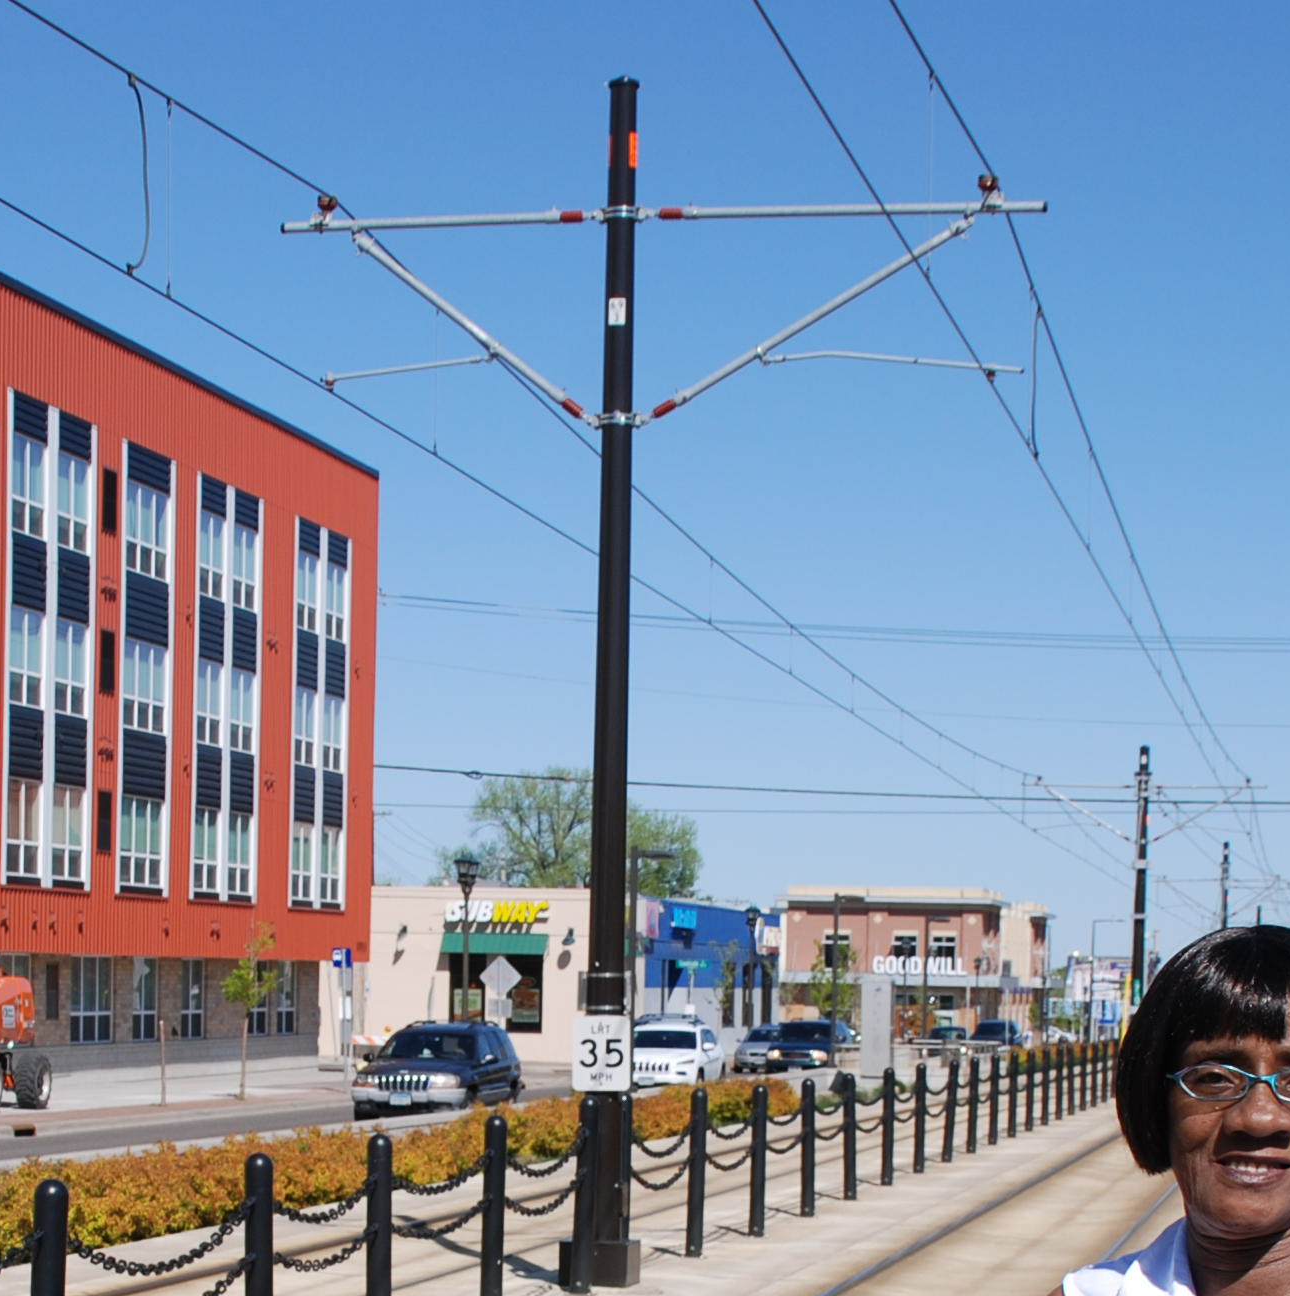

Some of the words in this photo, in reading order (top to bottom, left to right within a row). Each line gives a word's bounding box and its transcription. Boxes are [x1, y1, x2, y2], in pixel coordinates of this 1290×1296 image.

[444, 900, 550, 923] SUBWAY
[871, 955, 968, 976] GOODWILL
[579, 1038, 624, 1068] 35
[589, 1072, 613, 1081] MPH
